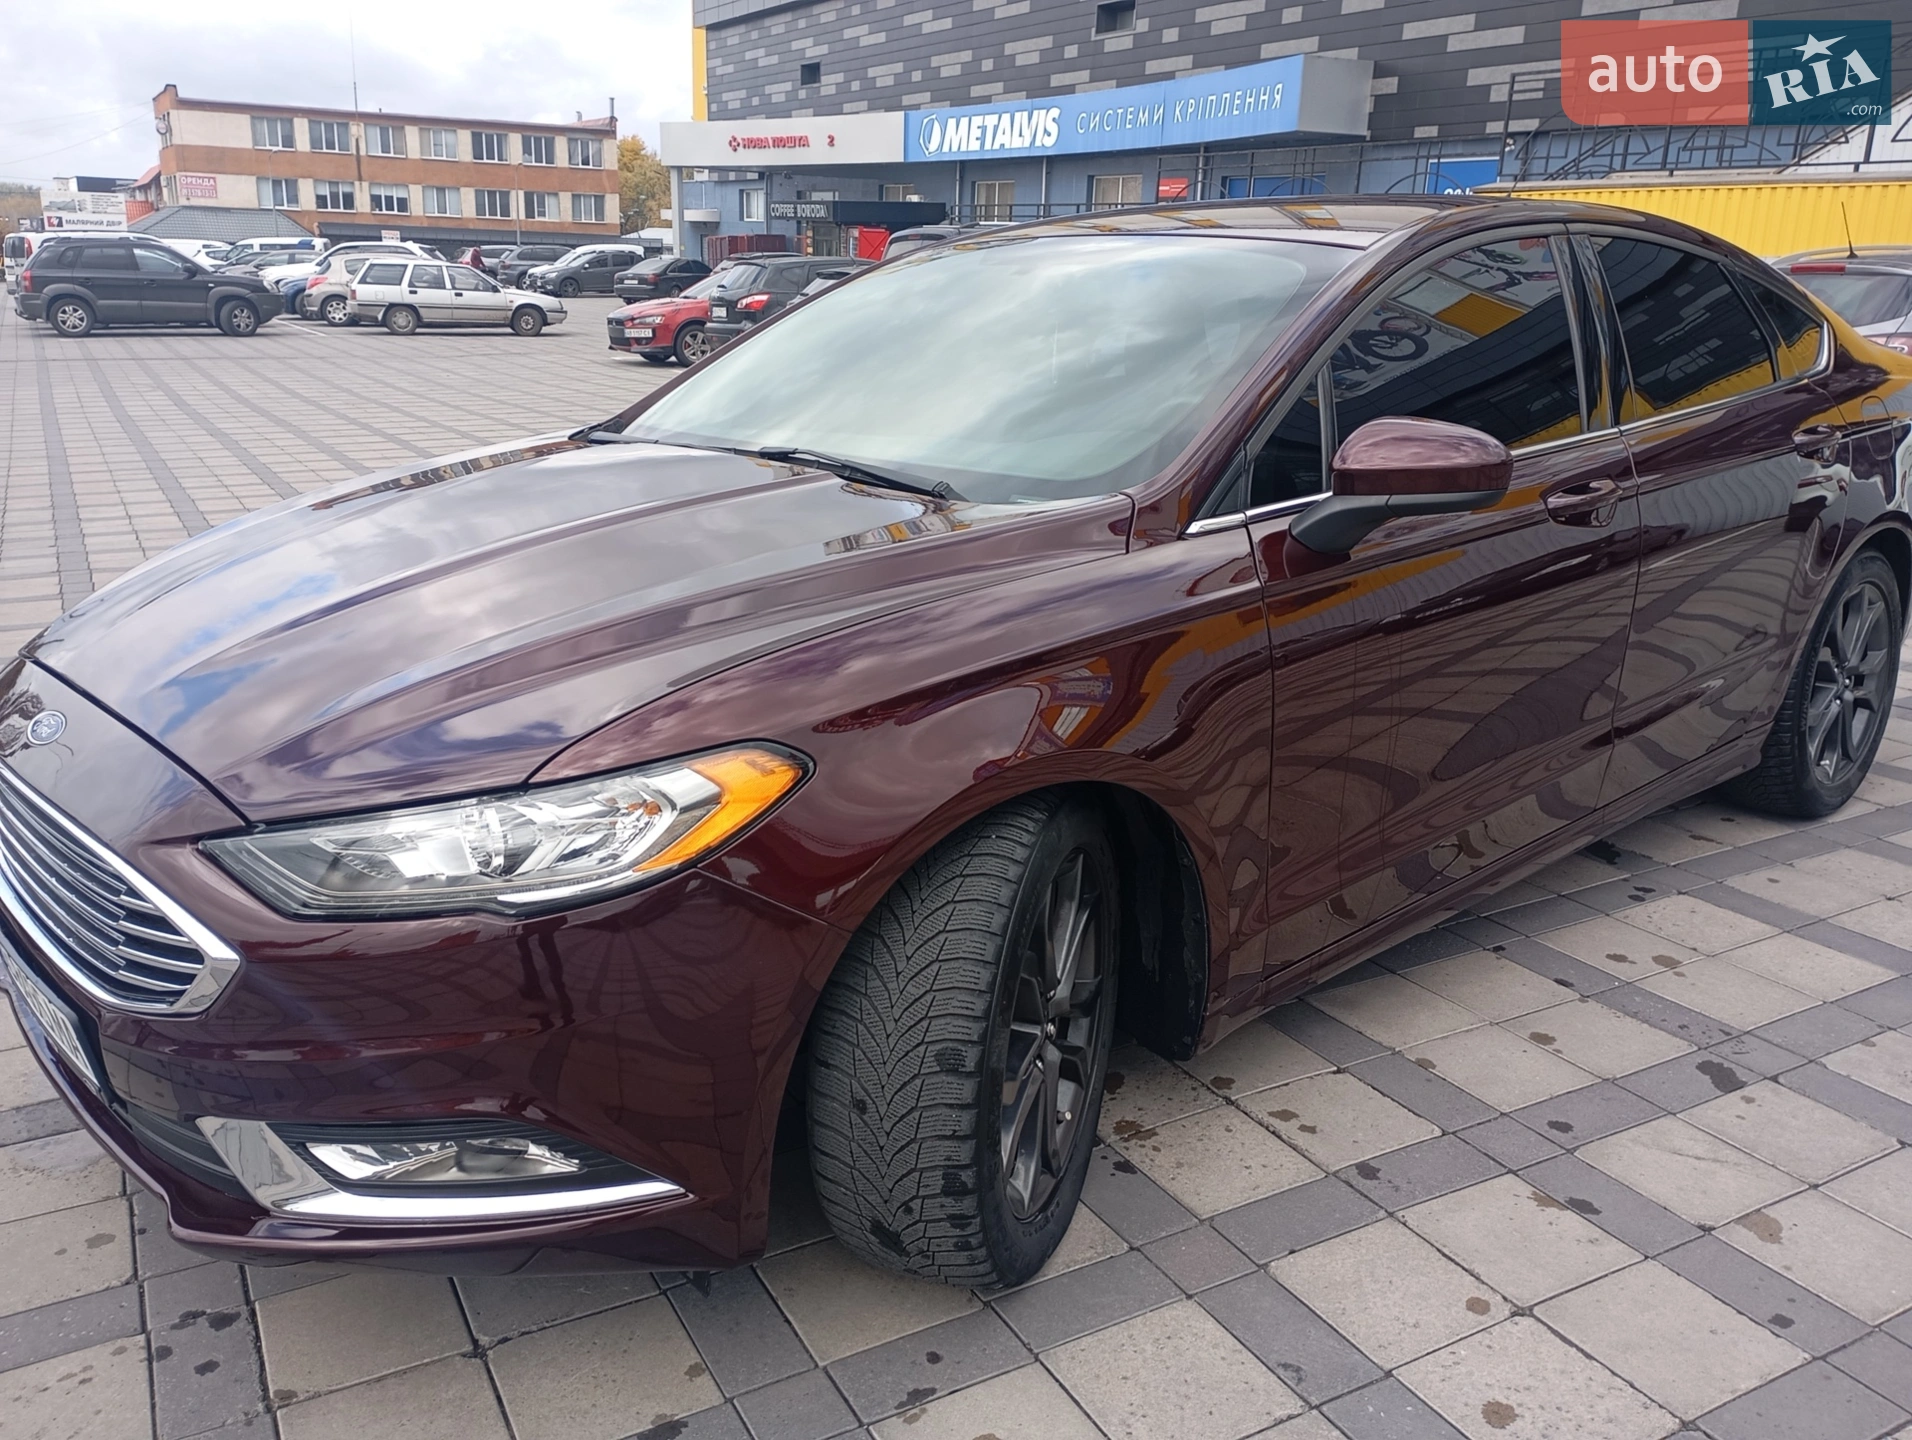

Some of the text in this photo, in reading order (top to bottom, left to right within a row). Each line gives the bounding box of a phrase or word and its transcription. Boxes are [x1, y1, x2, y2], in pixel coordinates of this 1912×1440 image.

[1076, 82, 1284, 135] СИСТЕМИ КРІПЛЕННЯ
[941, 106, 1061, 154] METALVIS
[740, 134, 835, 150] НОВА ПОШТА 2
[180, 176, 216, 187] ОРЕНДА
[770, 203, 795, 217] COFFEE
[65, 218, 123, 227] МАЛЯРНИЙ ДВІР
